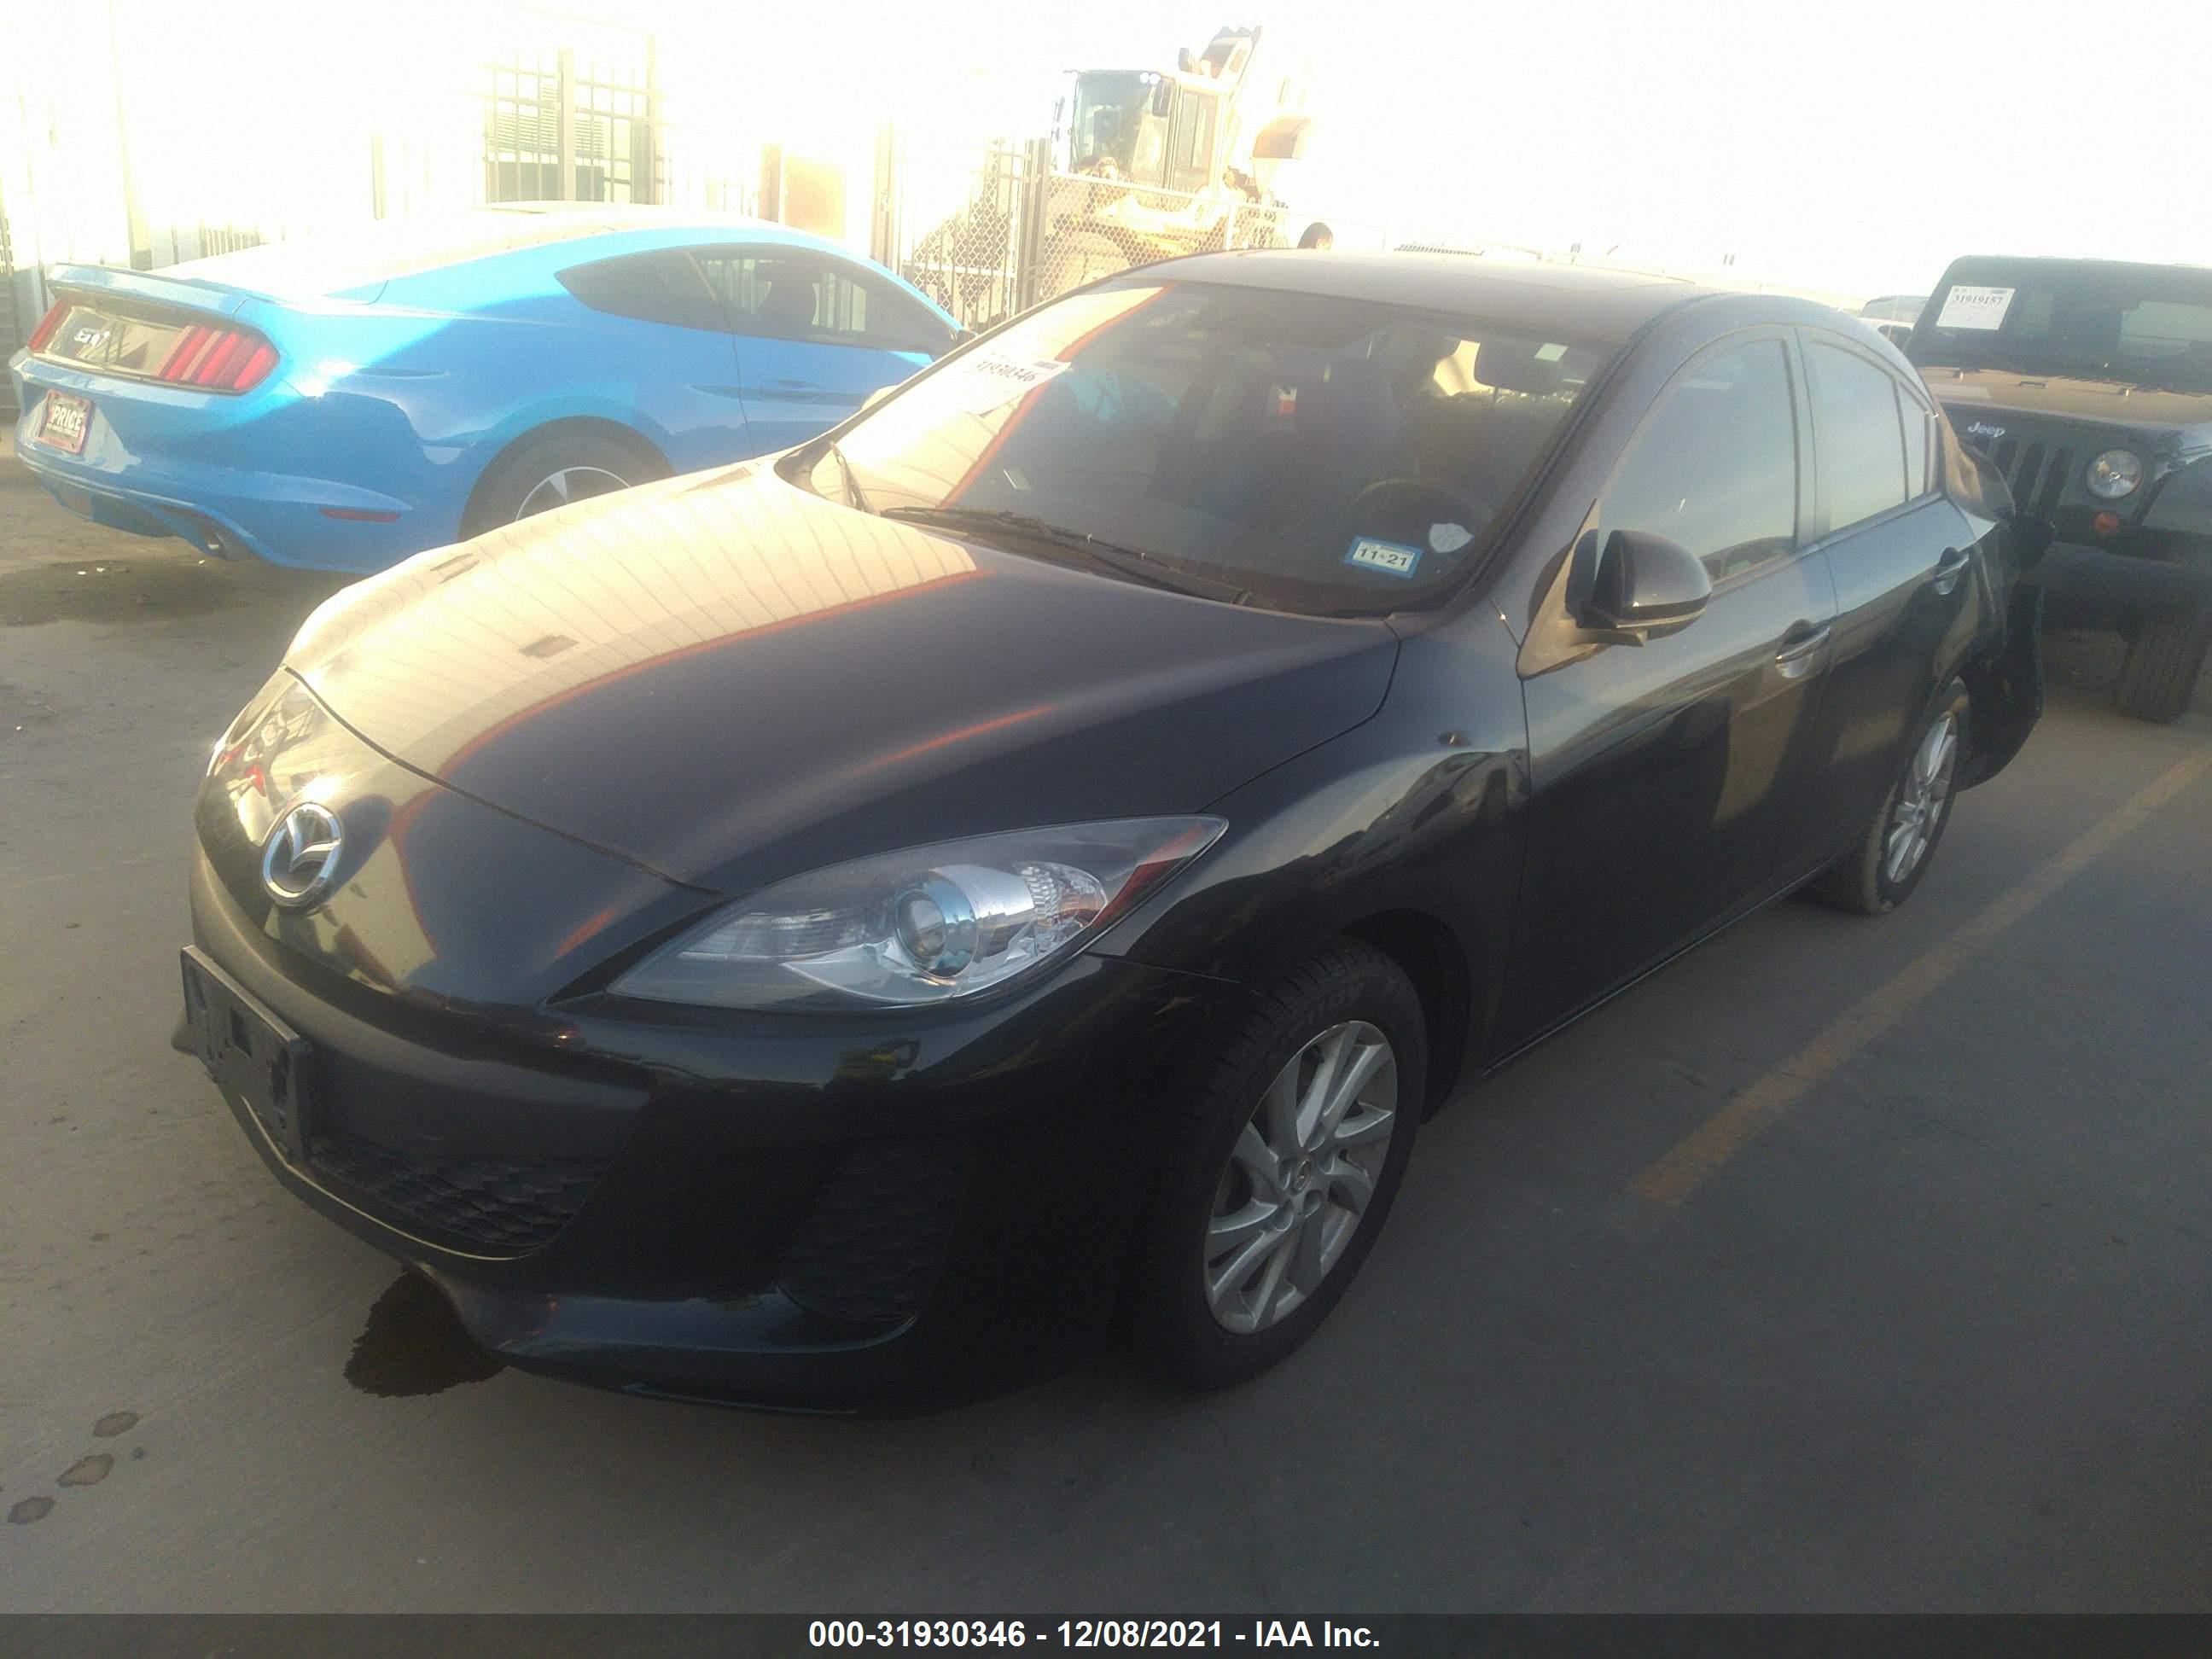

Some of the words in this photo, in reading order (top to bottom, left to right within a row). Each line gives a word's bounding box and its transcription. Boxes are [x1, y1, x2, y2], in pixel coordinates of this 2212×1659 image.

[1953, 294, 2004, 305] 31919157
[50, 405, 86, 431] PRICE
[1967, 422, 2005, 438] Jeep
